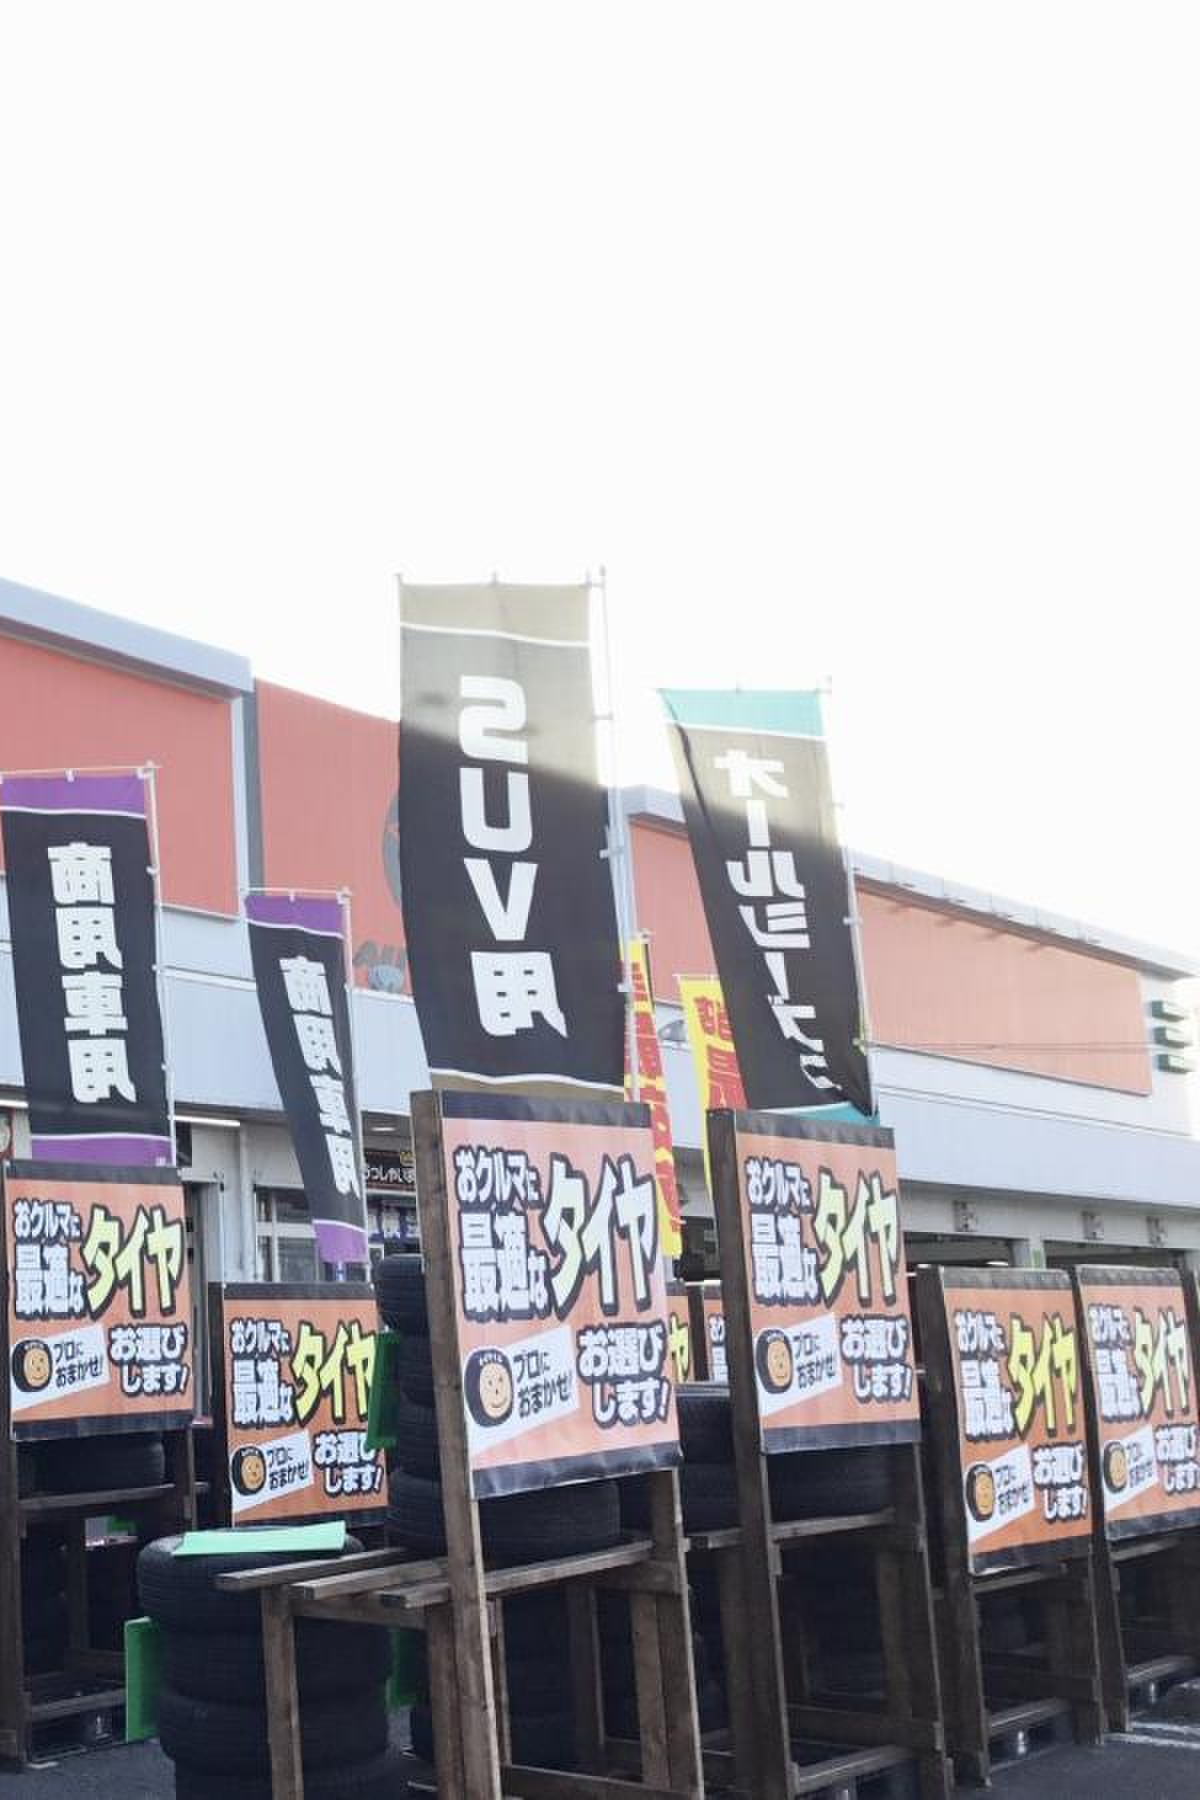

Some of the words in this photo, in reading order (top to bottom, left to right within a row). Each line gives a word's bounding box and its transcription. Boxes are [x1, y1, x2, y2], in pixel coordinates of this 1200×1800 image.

[455, 1150, 540, 1202] おクルマに
[746, 1159, 811, 1207] おクルマに
[14, 1200, 81, 1238] おクルマに
[544, 1158, 656, 1312] タイヤ
[814, 1173, 897, 1300] タイヤ
[15, 1243, 86, 1314] 最適な
[83, 1206, 183, 1314] タイヤ
[460, 1210, 548, 1312] 最適な
[752, 1213, 819, 1300] 最適な
[109, 1325, 186, 1362] お選び
[231, 1319, 291, 1353] おクルマに
[578, 1327, 665, 1376] お選び
[842, 1316, 909, 1359] お選び
[1133, 1310, 1187, 1413] タイヤ
[120, 1362, 189, 1394] します!
[233, 1358, 294, 1424] 最適な
[292, 1322, 376, 1421] タイヤ
[593, 1379, 672, 1424] します!
[1008, 1316, 1076, 1433] タイヤ
